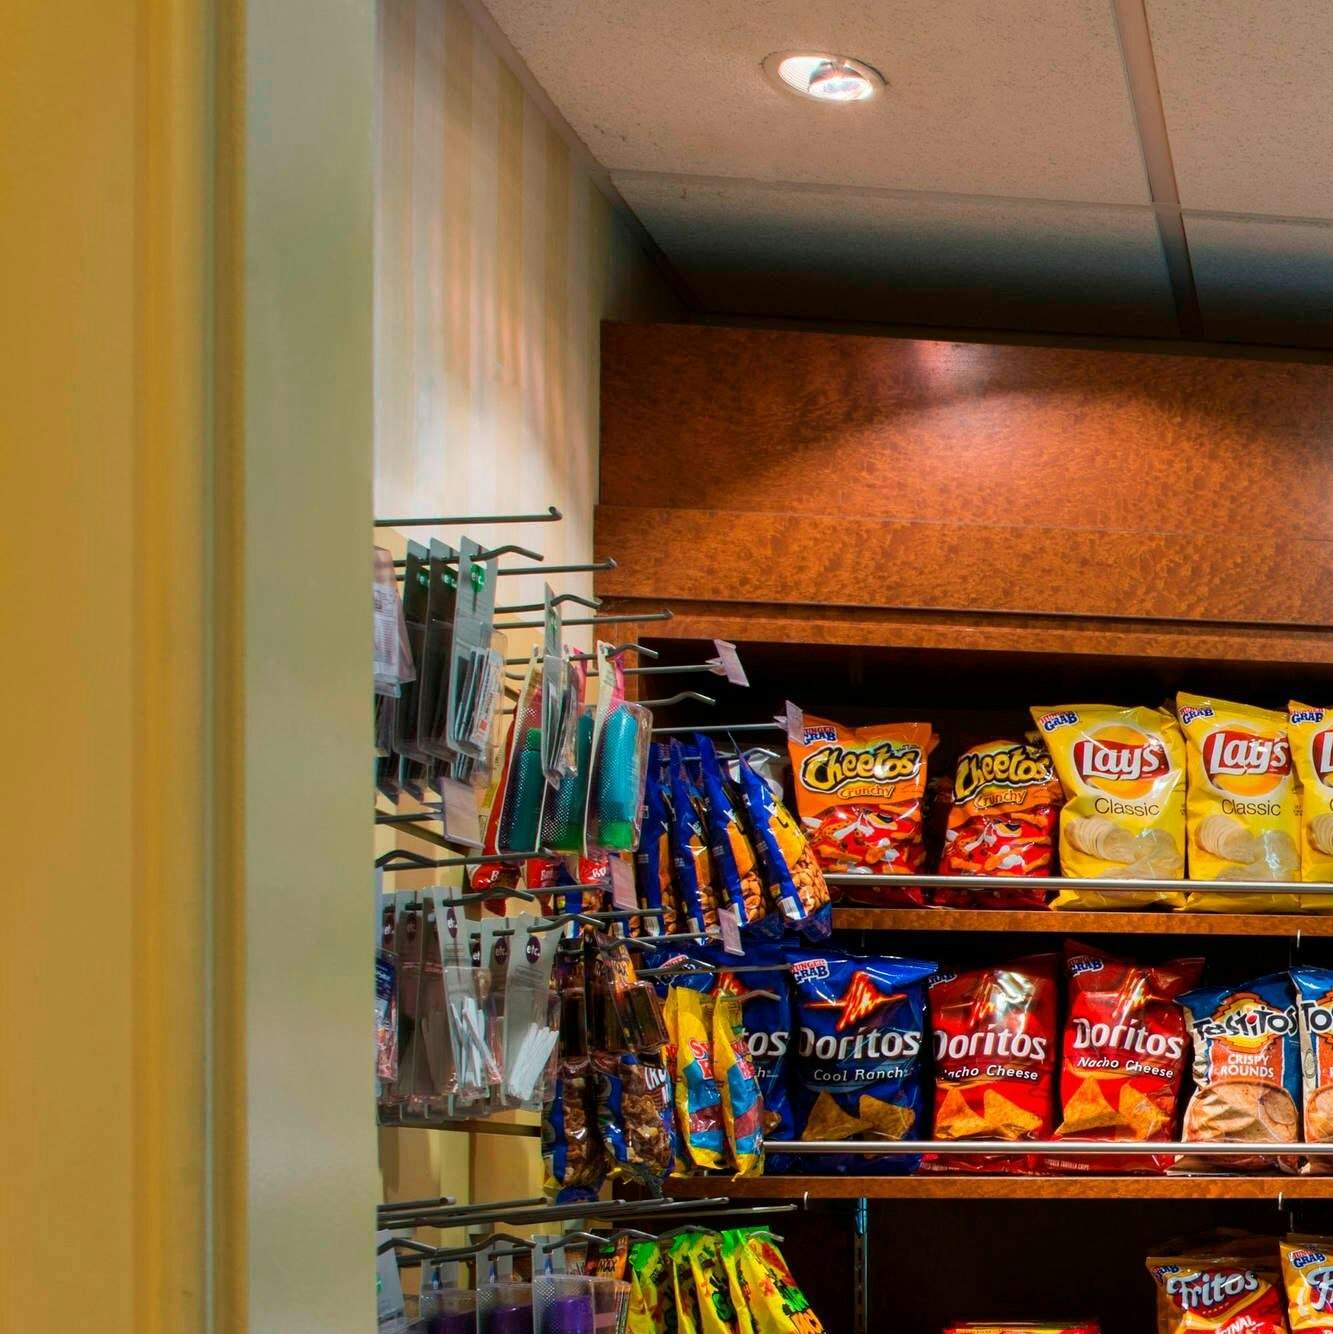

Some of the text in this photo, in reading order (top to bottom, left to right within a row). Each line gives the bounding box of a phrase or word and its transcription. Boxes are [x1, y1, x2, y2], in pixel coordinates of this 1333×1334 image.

[801, 742, 923, 793] Cheetos
[952, 743, 1056, 804] Cheetos
[837, 785, 895, 799] Crunchy
[1095, 797, 1160, 816] Classic
[1221, 798, 1281, 816] Classic
[1073, 1018, 1183, 1060] Doritos
[1077, 1056, 1174, 1079] Nacho Cheese
[1227, 1052, 1271, 1067] CRISPY
[813, 1068, 904, 1081] Cool Ranch
[986, 1064, 1039, 1080] Cheese
[1220, 1064, 1275, 1079] ROUNDS
[1168, 1267, 1259, 1308] Fritos
